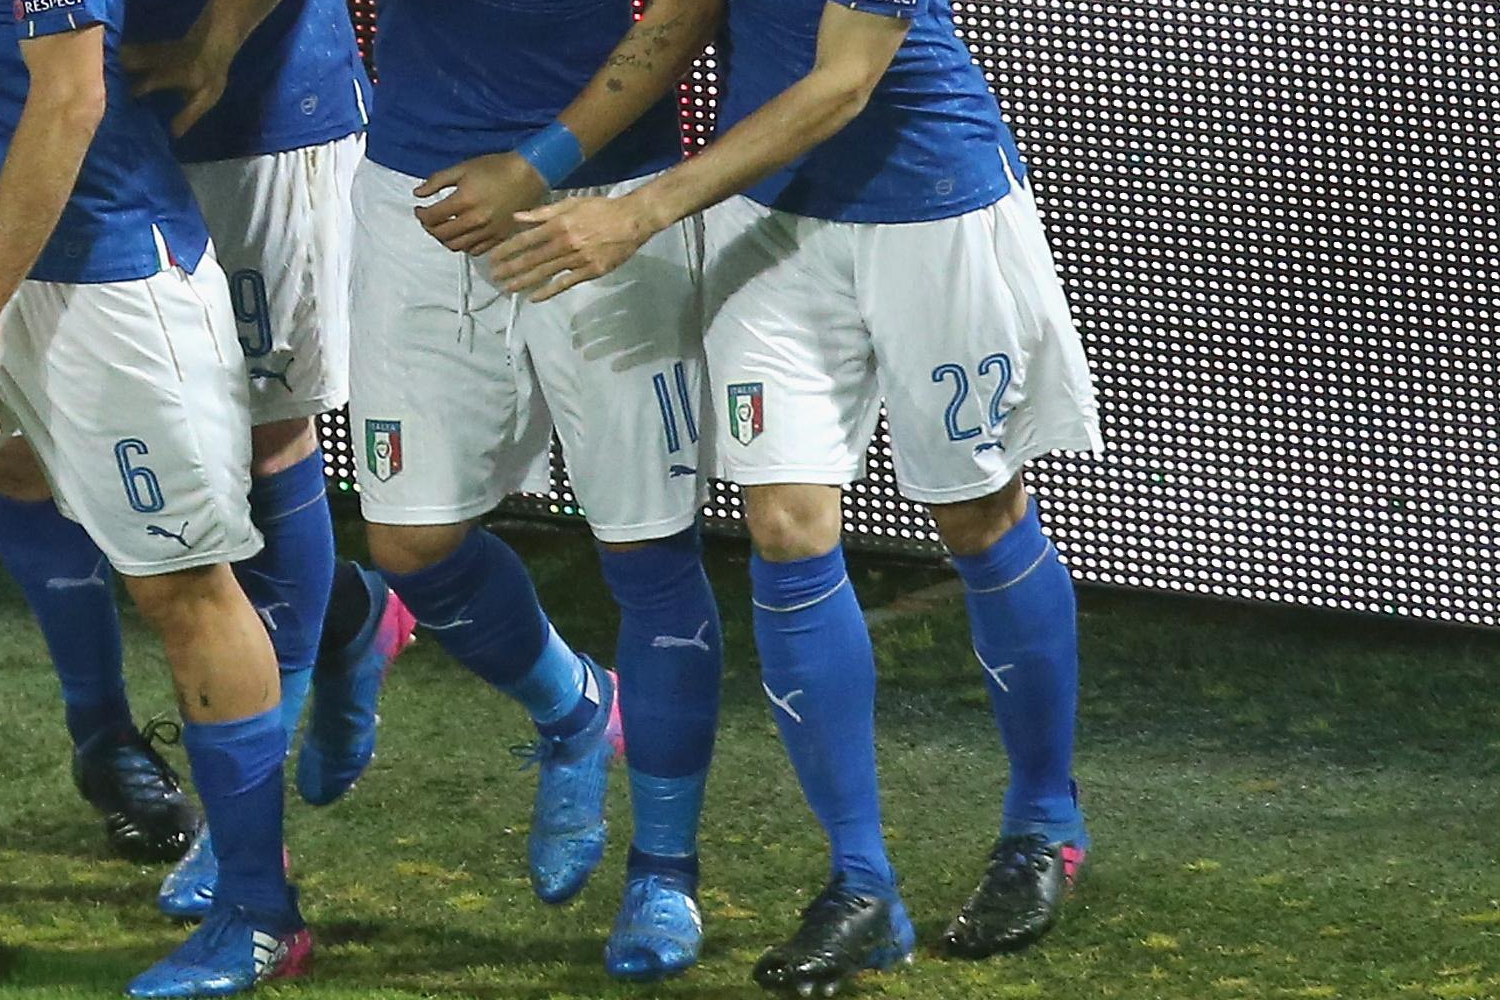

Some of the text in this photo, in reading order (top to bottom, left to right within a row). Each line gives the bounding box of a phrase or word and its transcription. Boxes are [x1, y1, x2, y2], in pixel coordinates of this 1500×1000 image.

[232, 268, 272, 358] 9
[652, 361, 698, 454] 11
[931, 352, 1014, 441] 22
[114, 438, 165, 513] 6
